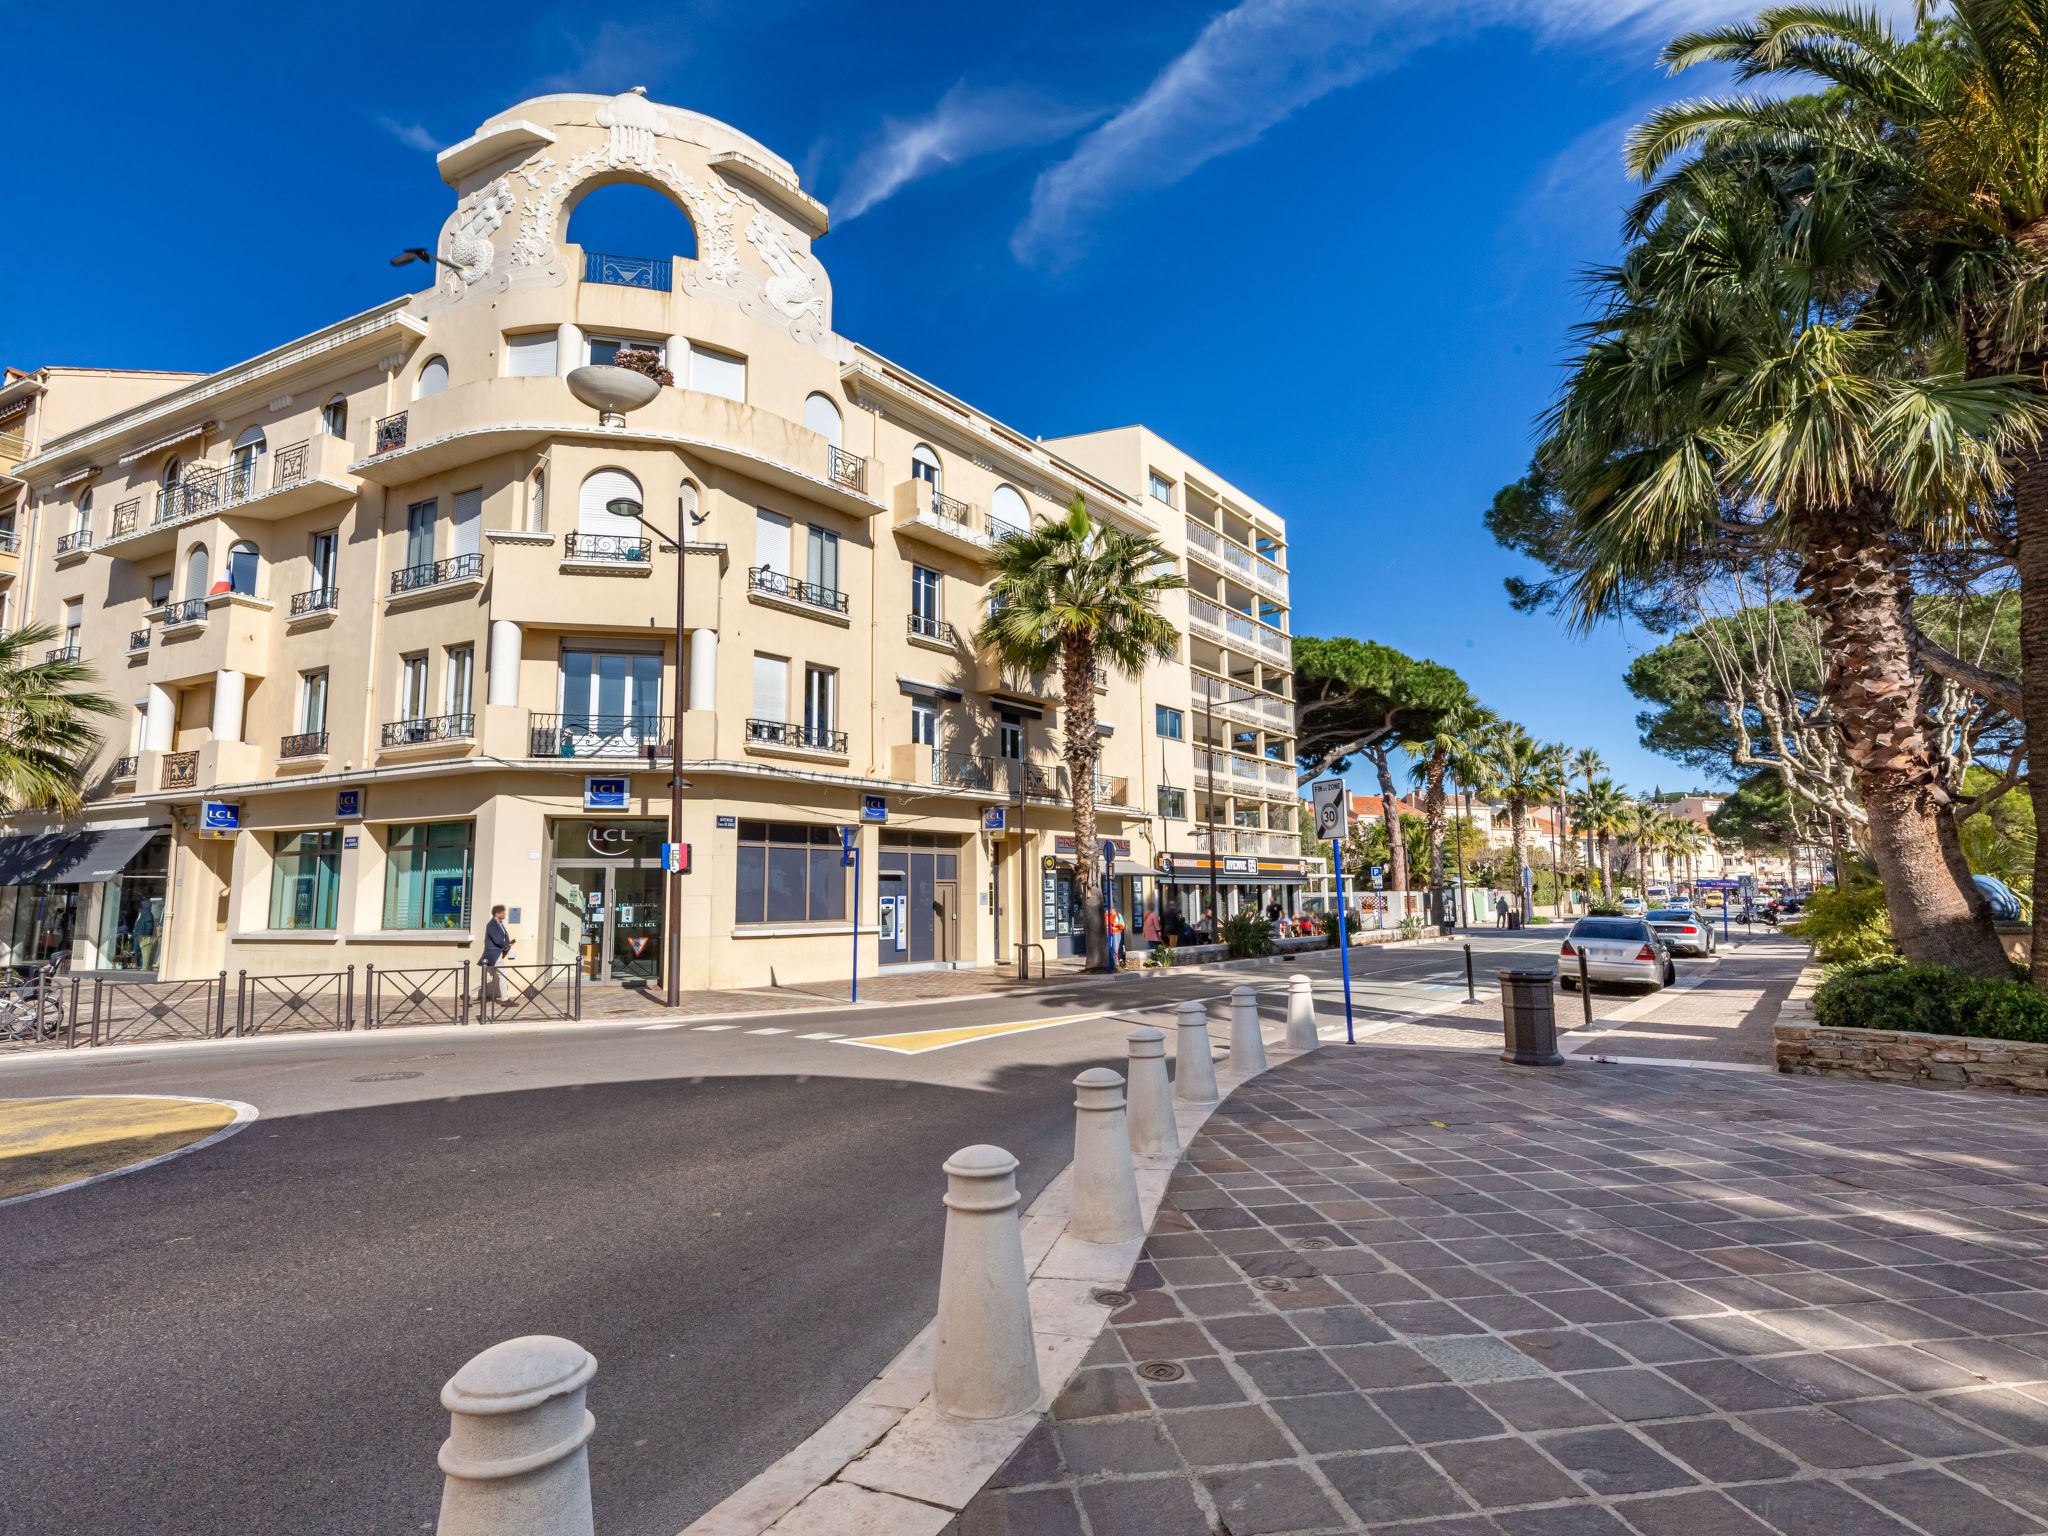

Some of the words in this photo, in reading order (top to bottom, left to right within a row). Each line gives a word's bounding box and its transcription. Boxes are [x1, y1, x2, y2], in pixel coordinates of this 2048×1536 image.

[593, 785, 617, 793] LCL
[1327, 783, 1341, 791] ZONE
[340, 796, 356, 805] LCL
[866, 800, 882, 808] LCL
[209, 810, 235, 819] LCL
[1324, 811, 1335, 822] 30
[592, 829, 633, 841] LCL
